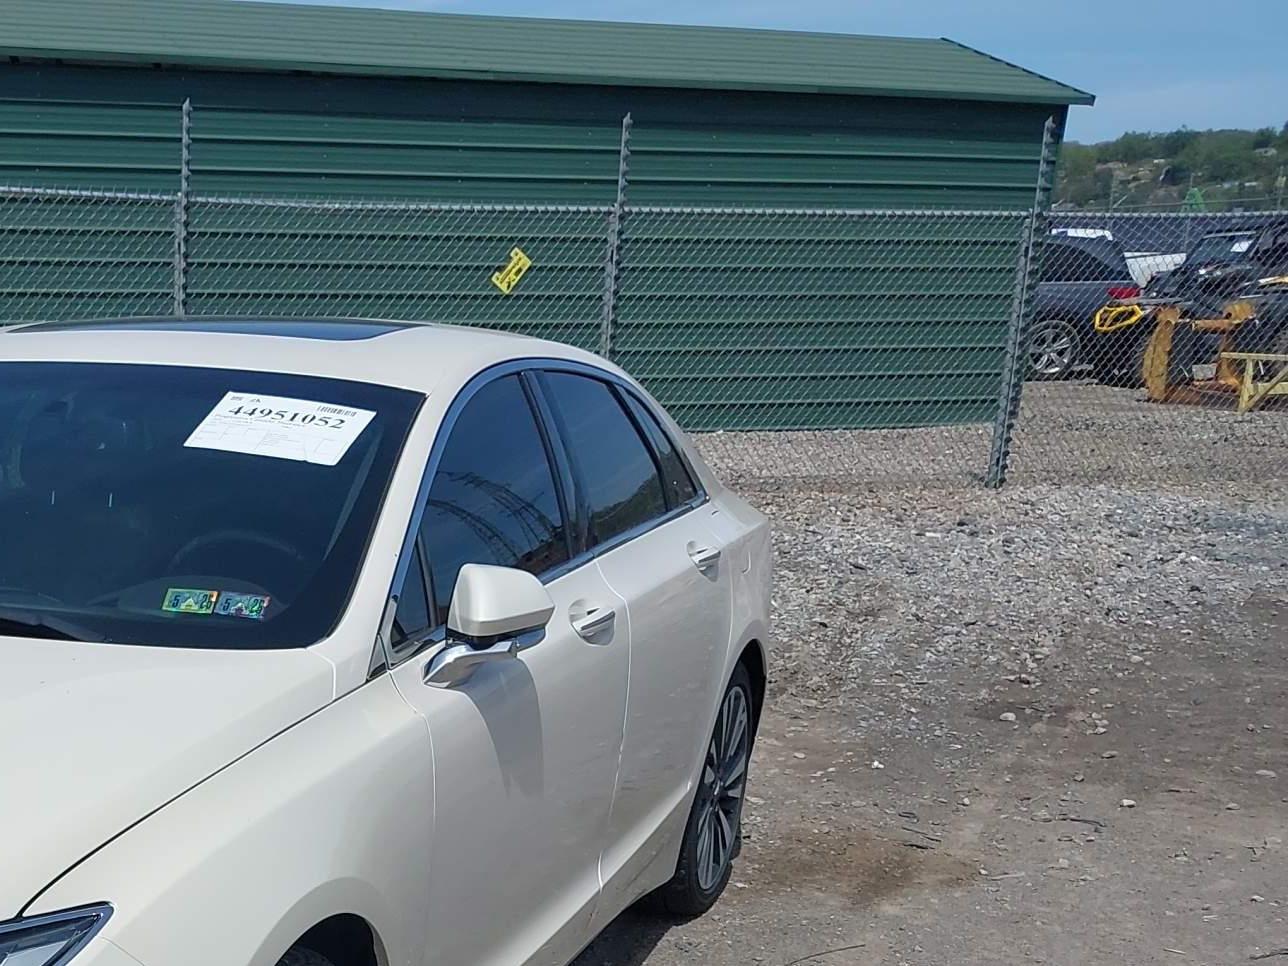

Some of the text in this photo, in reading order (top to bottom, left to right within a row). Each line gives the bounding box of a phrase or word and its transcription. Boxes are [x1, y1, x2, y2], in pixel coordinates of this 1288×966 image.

[228, 405, 346, 429] 44951052
[172, 595, 181, 607] 5
[222, 598, 232, 611] 5
